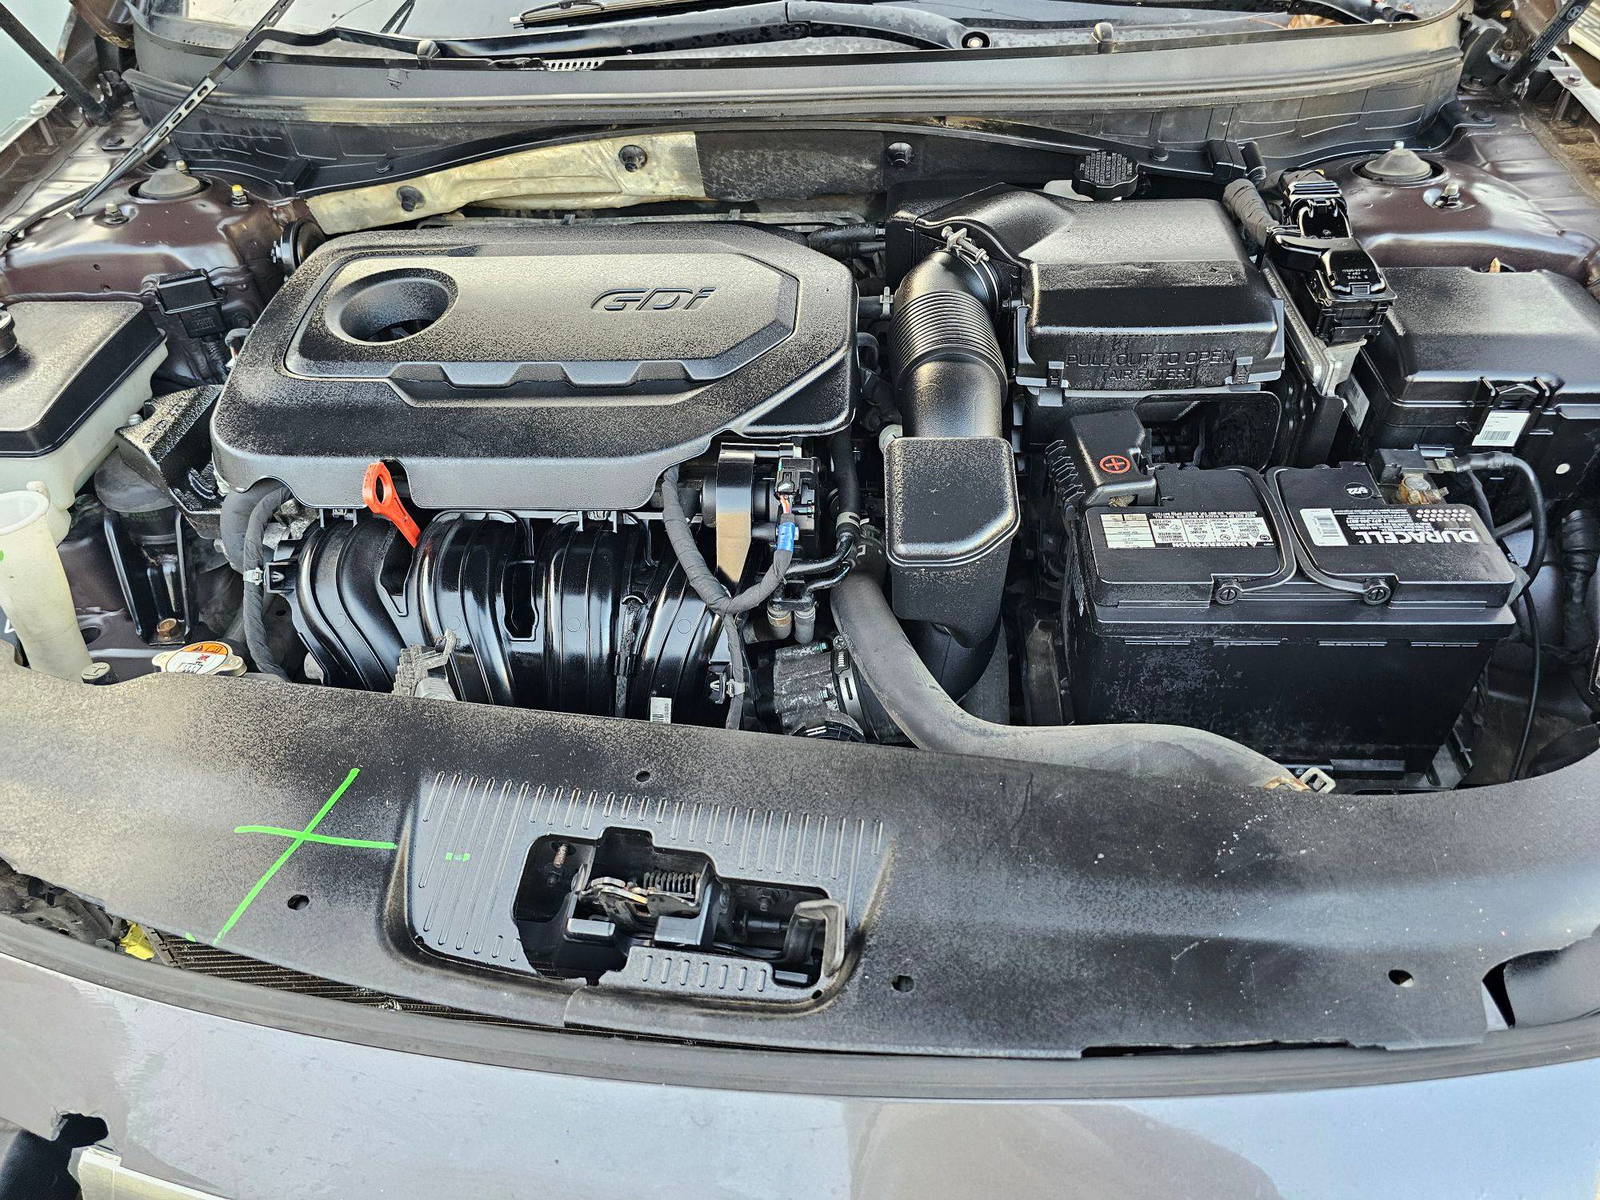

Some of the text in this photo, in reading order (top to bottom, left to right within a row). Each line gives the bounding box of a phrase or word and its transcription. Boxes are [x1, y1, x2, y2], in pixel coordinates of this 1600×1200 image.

[1065, 350, 1235, 367] PULL OUT TO OPEN
[1355, 529, 1479, 544] DURACELL
